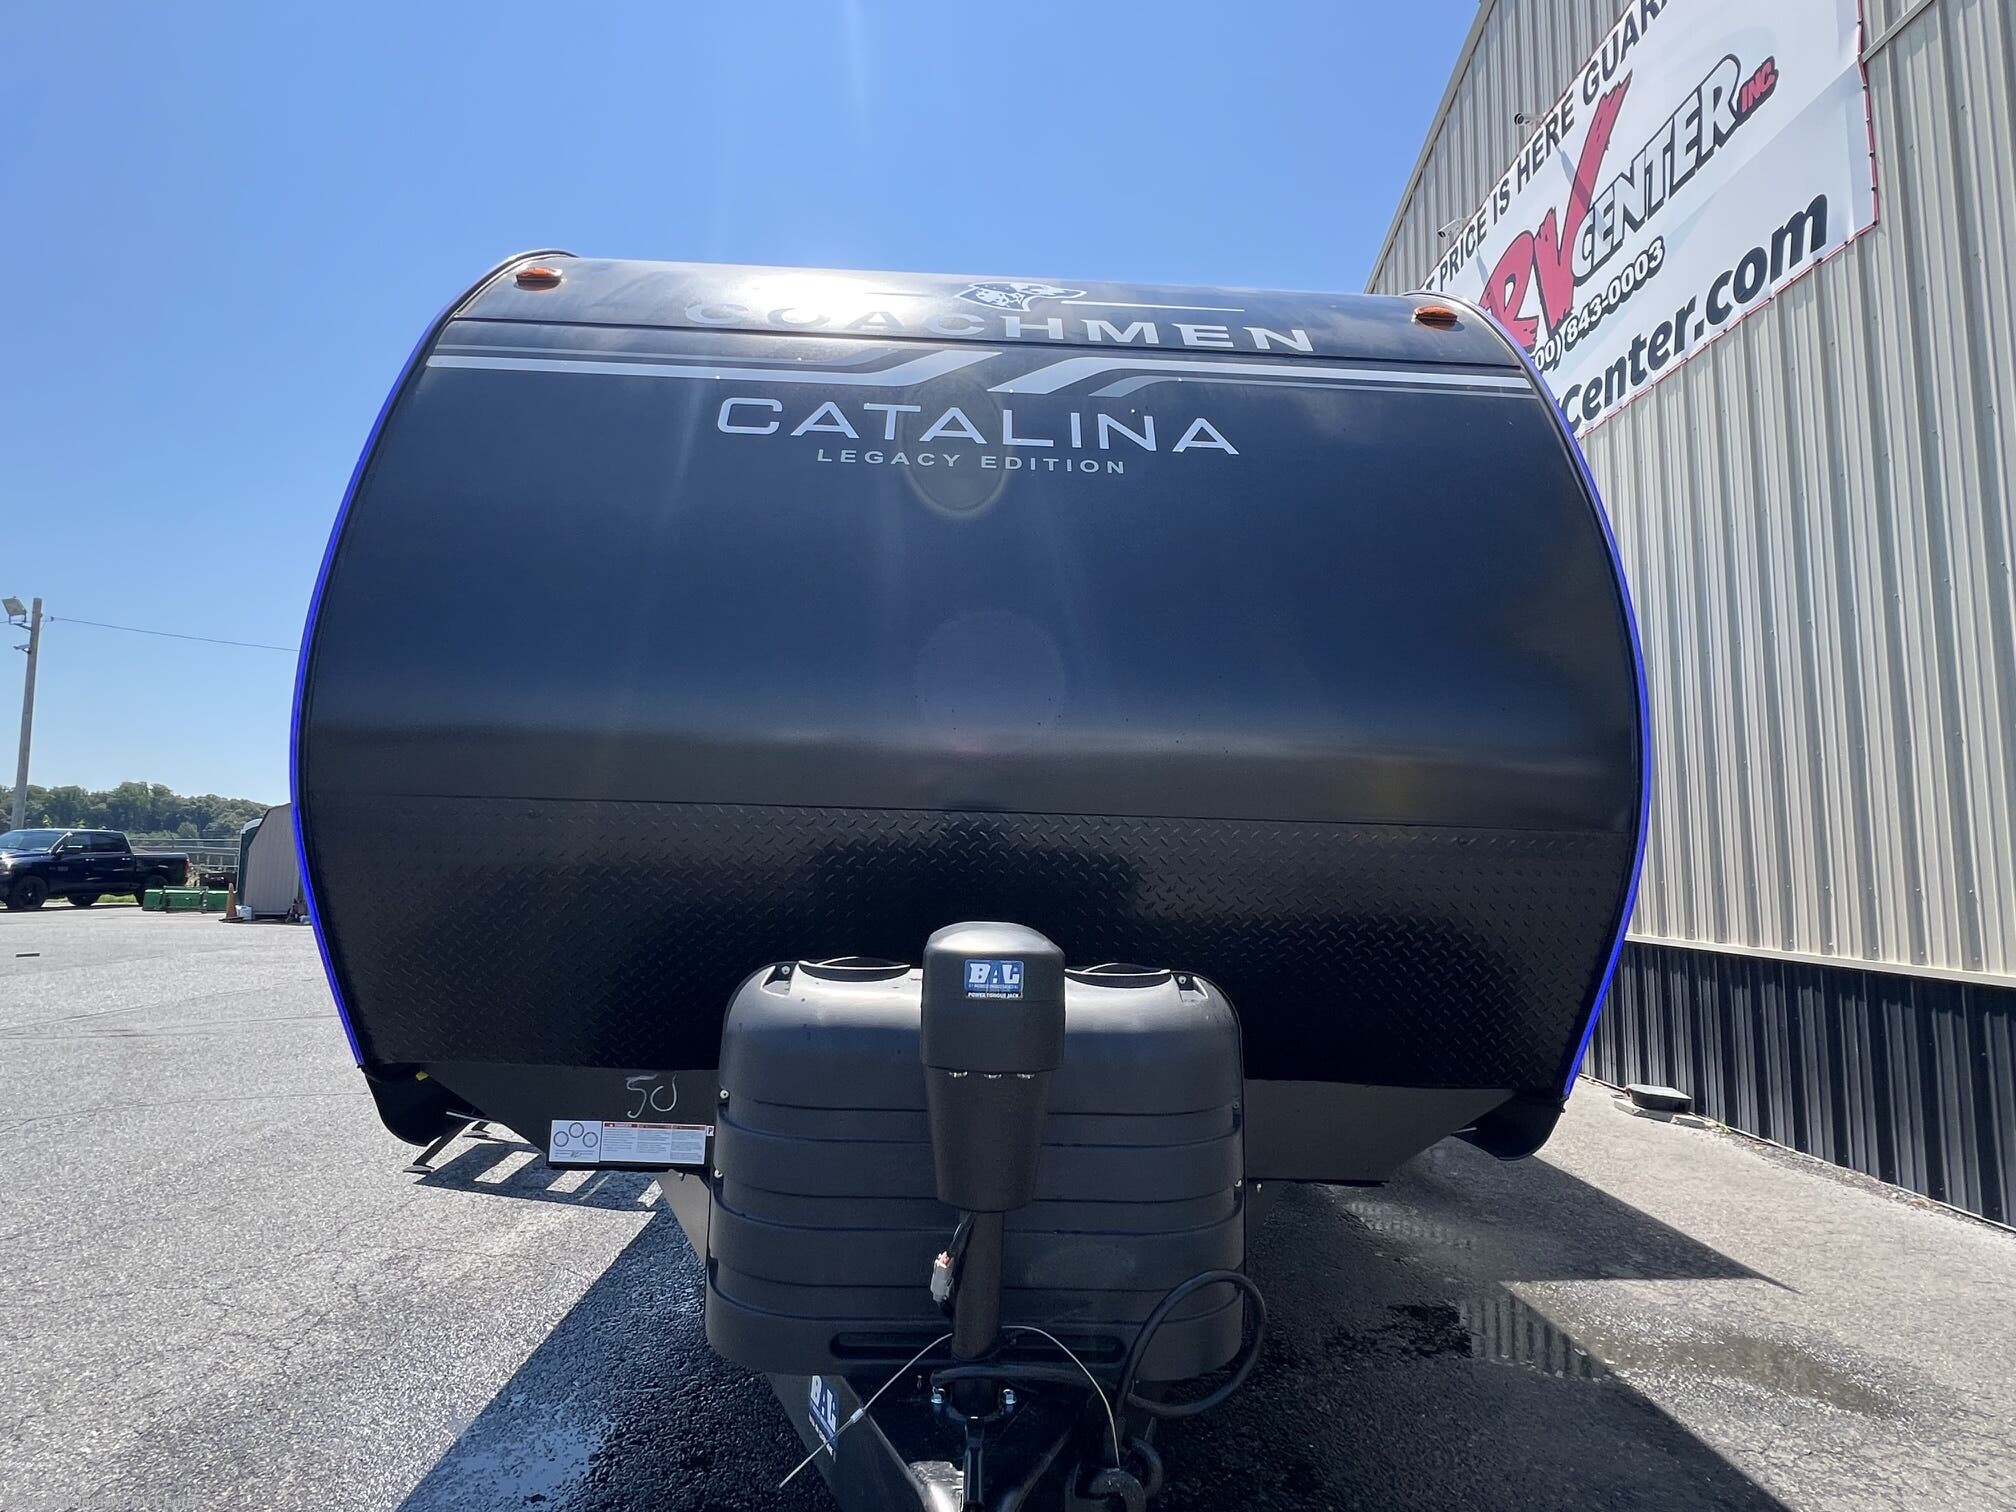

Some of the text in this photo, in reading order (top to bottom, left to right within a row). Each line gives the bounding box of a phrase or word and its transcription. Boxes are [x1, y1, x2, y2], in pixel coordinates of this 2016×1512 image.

[1440, 0, 1667, 292] PRICE IS HERE GUAR
[1479, 68, 1632, 354] RV
[1571, 53, 1742, 288] CENTER
[685, 302, 1313, 352] COACHMEN
[1558, 194, 1828, 433] center.com
[1564, 236, 1665, 352] 843-0003
[716, 397, 1240, 456] CATALINA
[817, 449, 1126, 475] LEGACY EDITION
